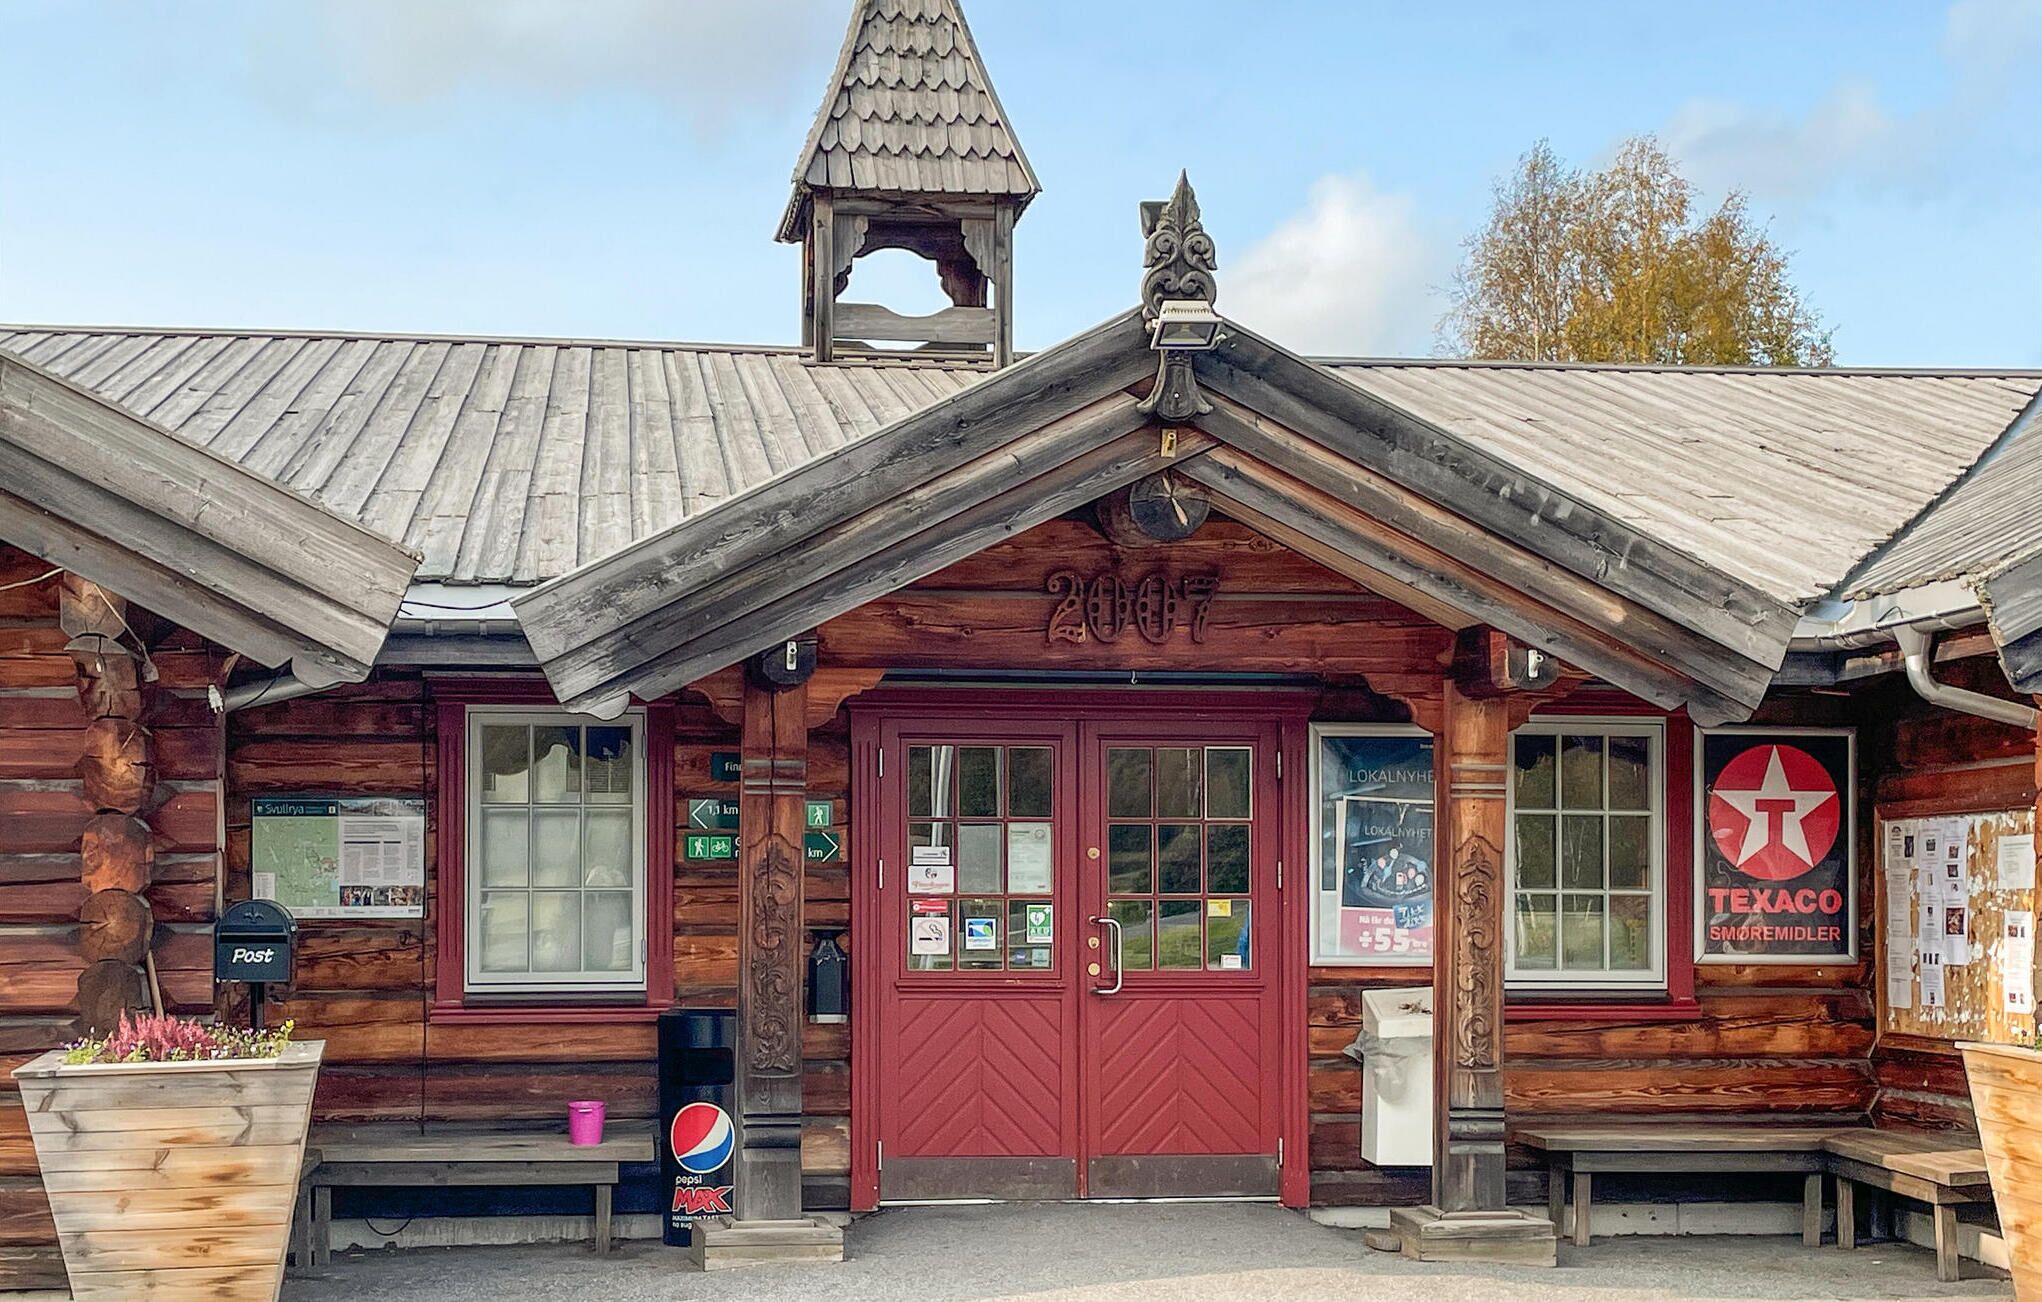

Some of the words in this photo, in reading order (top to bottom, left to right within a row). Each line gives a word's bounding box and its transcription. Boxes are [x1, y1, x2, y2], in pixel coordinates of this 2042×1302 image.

[1047, 569, 1220, 644] 2007
[723, 804, 739, 815] km
[808, 847, 823, 858] km
[1708, 888, 1842, 914] TEXACO
[1710, 926, 1841, 941] SMØREMIDLER
[232, 948, 274, 963] Post
[676, 1175, 702, 1185] pepsi
[672, 1185, 734, 1214] MAX
